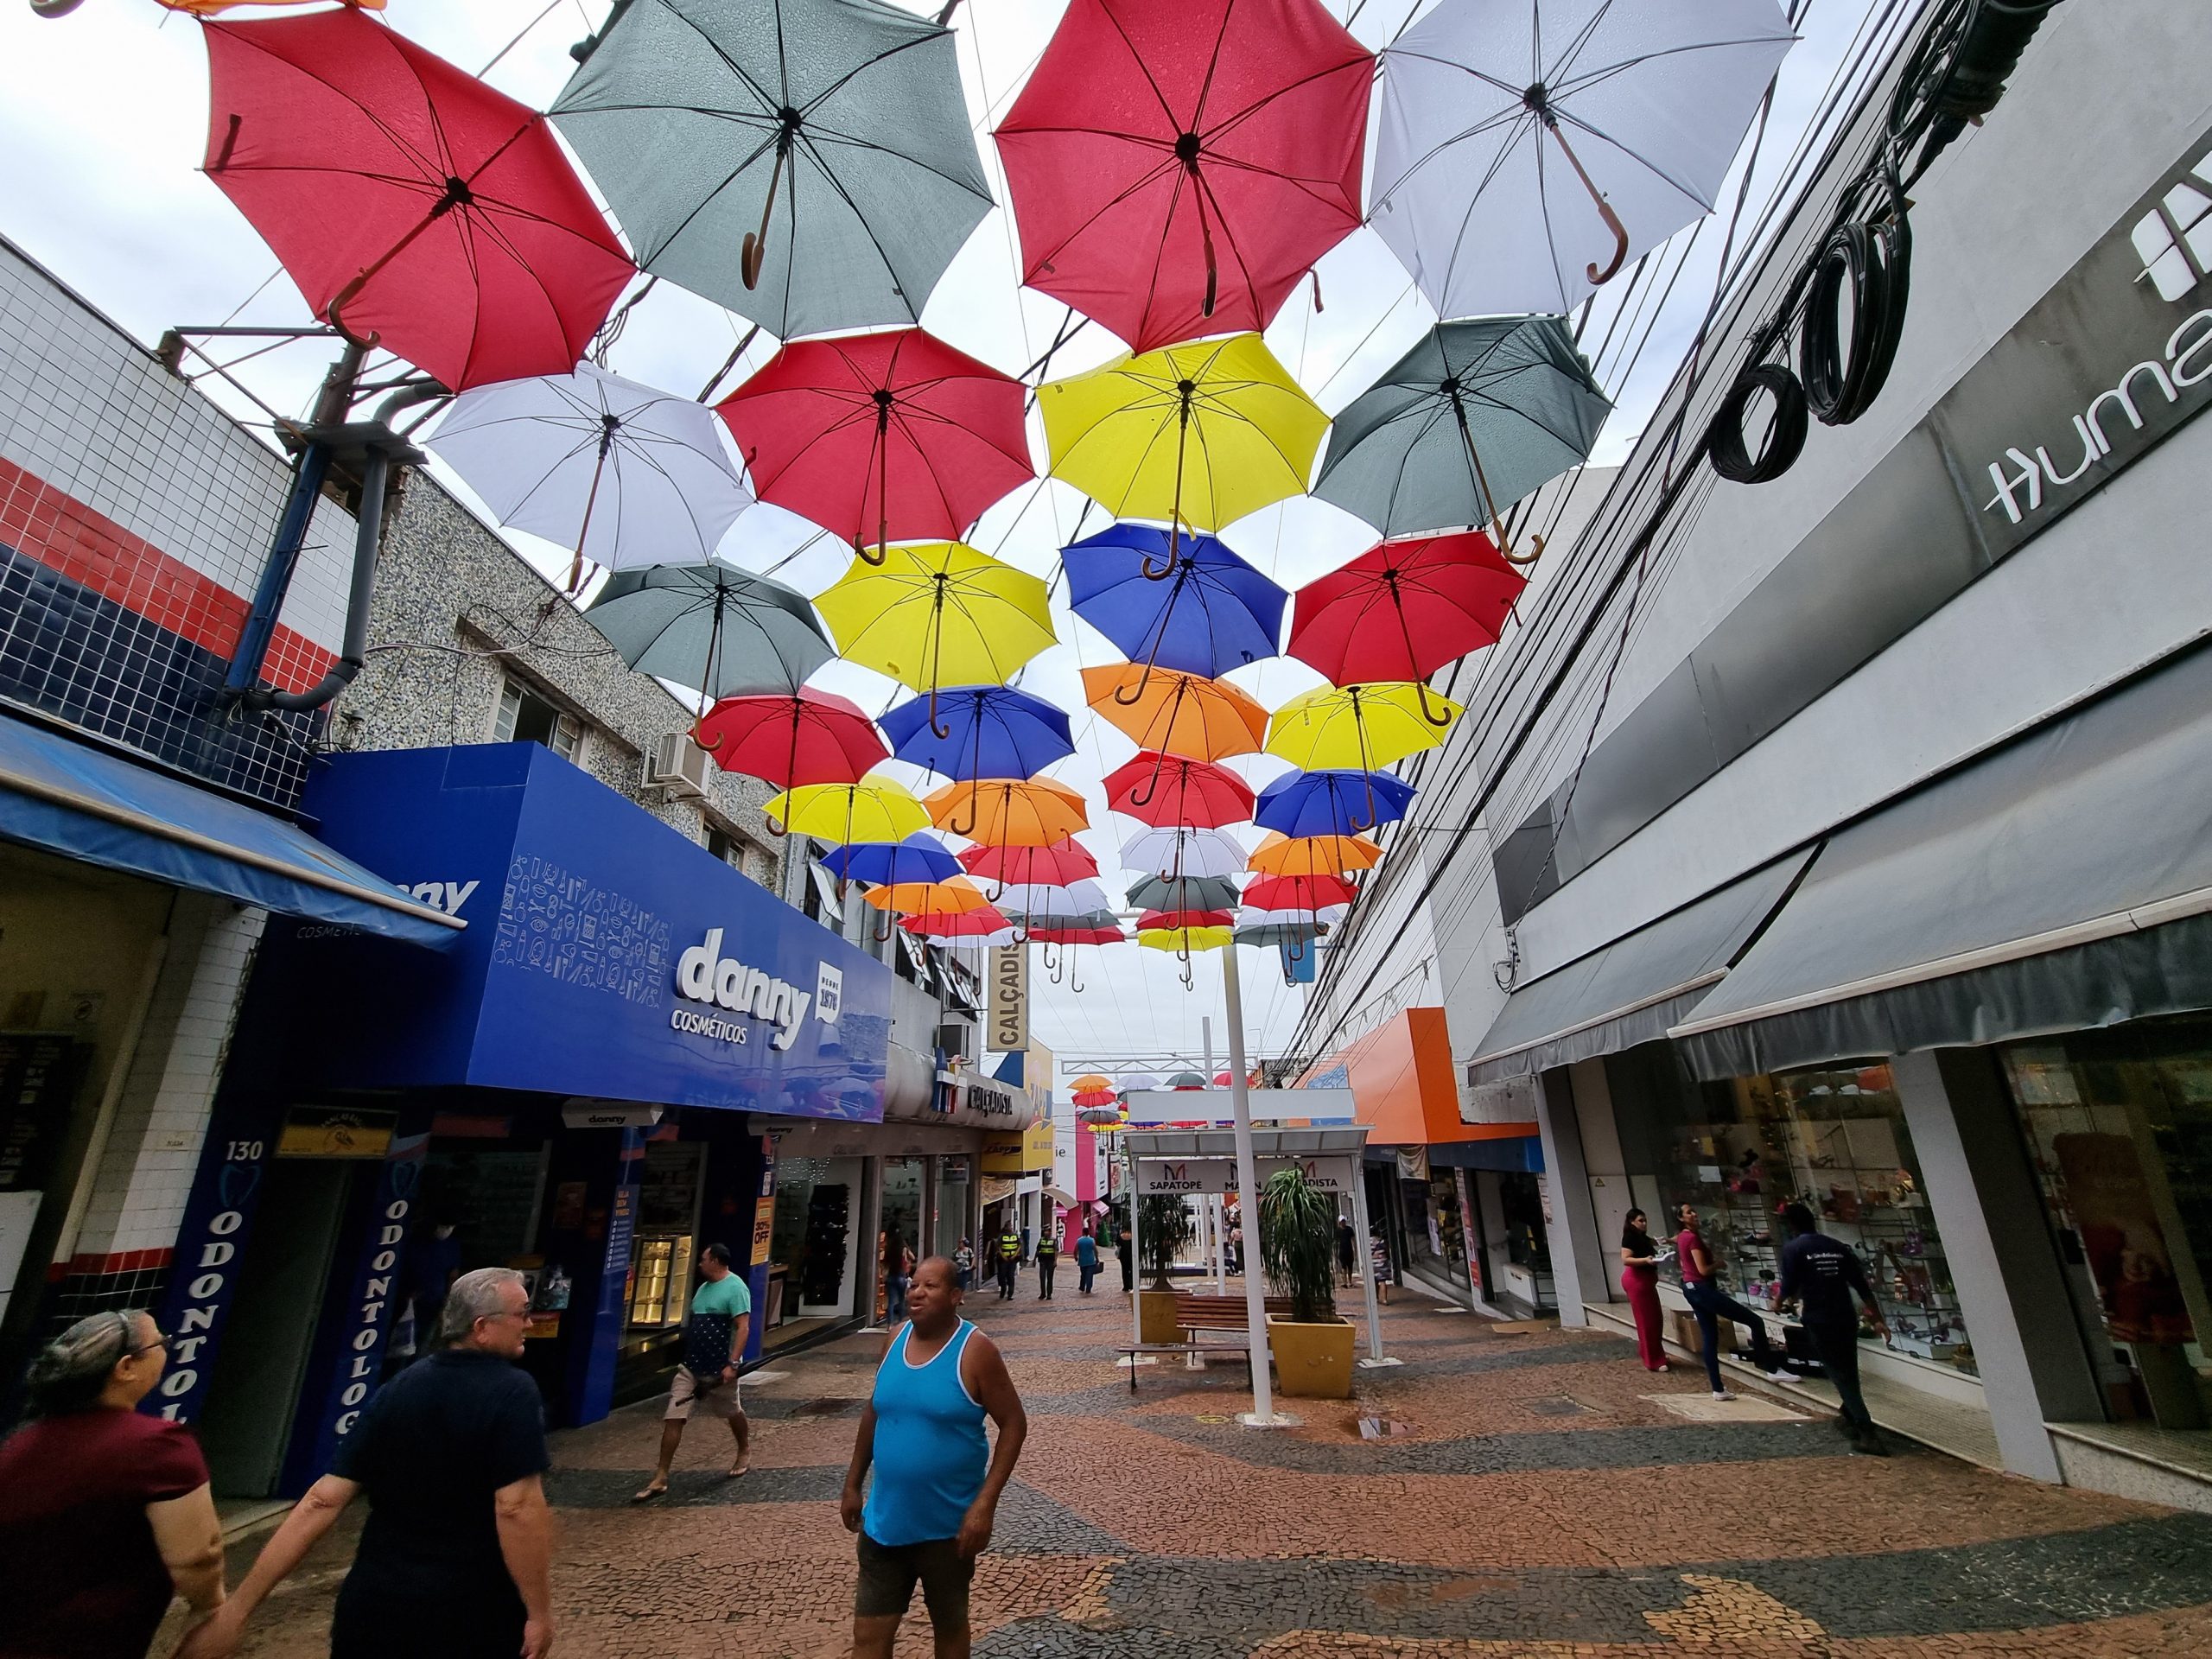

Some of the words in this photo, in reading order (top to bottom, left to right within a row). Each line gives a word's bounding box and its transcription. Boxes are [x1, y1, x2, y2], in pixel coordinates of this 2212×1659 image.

[677, 927, 812, 1052] danny
[671, 1009, 748, 1045] COSMÉTICOS
[968, 1084, 1014, 1118] CALÇADISTA
[588, 1115, 626, 1125] danny
[226, 1141, 264, 1160] 130
[754, 1230, 770, 1244] OFF
